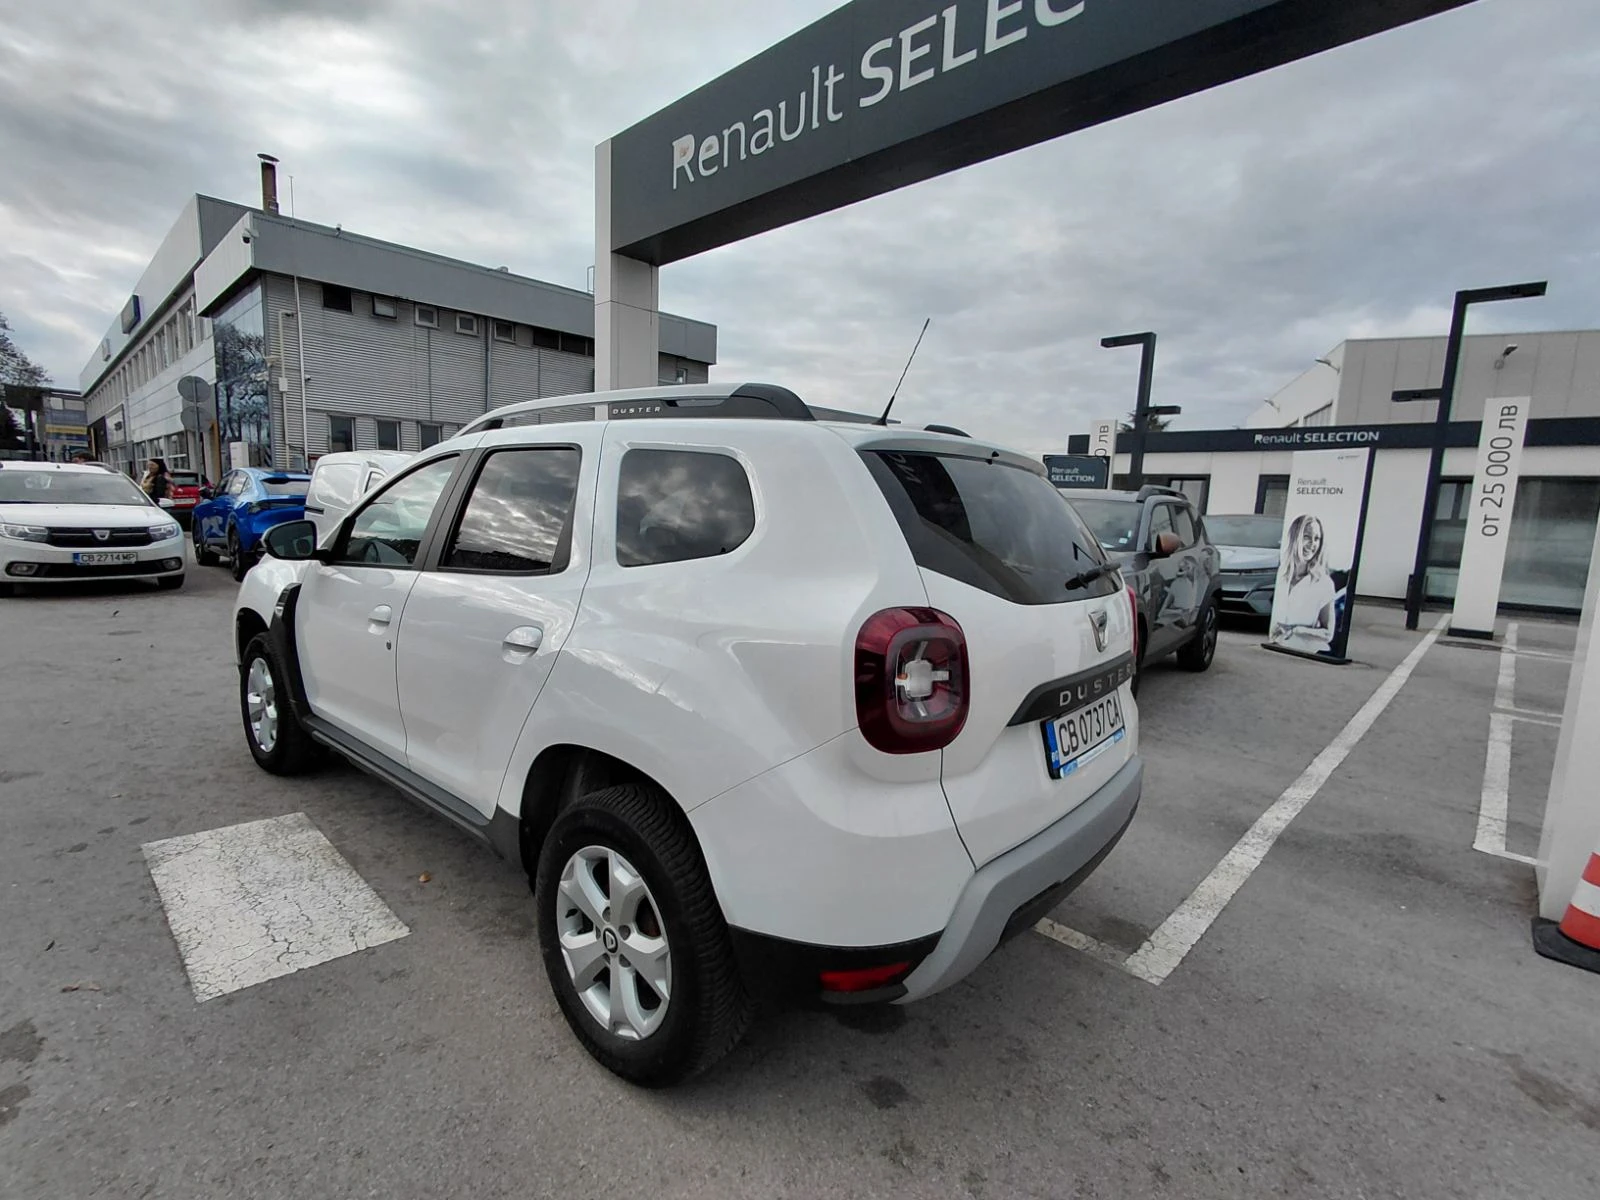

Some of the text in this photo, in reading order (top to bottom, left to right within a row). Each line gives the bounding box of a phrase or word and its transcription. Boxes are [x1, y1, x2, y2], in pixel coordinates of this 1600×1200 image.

[671, 64, 845, 190] Renault
[612, 406, 661, 415] DUSTER
[1254, 431, 1380, 444] Renault SELECTION
[1485, 437, 1513, 477] 000
[1296, 487, 1344, 495] SELECTION
[1297, 478, 1327, 486] Renault
[1480, 483, 1505, 508] 25
[1060, 663, 1135, 706] DUSTER
[1058, 719, 1079, 757] CB
[1079, 702, 1105, 745] 0737
[1106, 696, 1121, 728] CA
